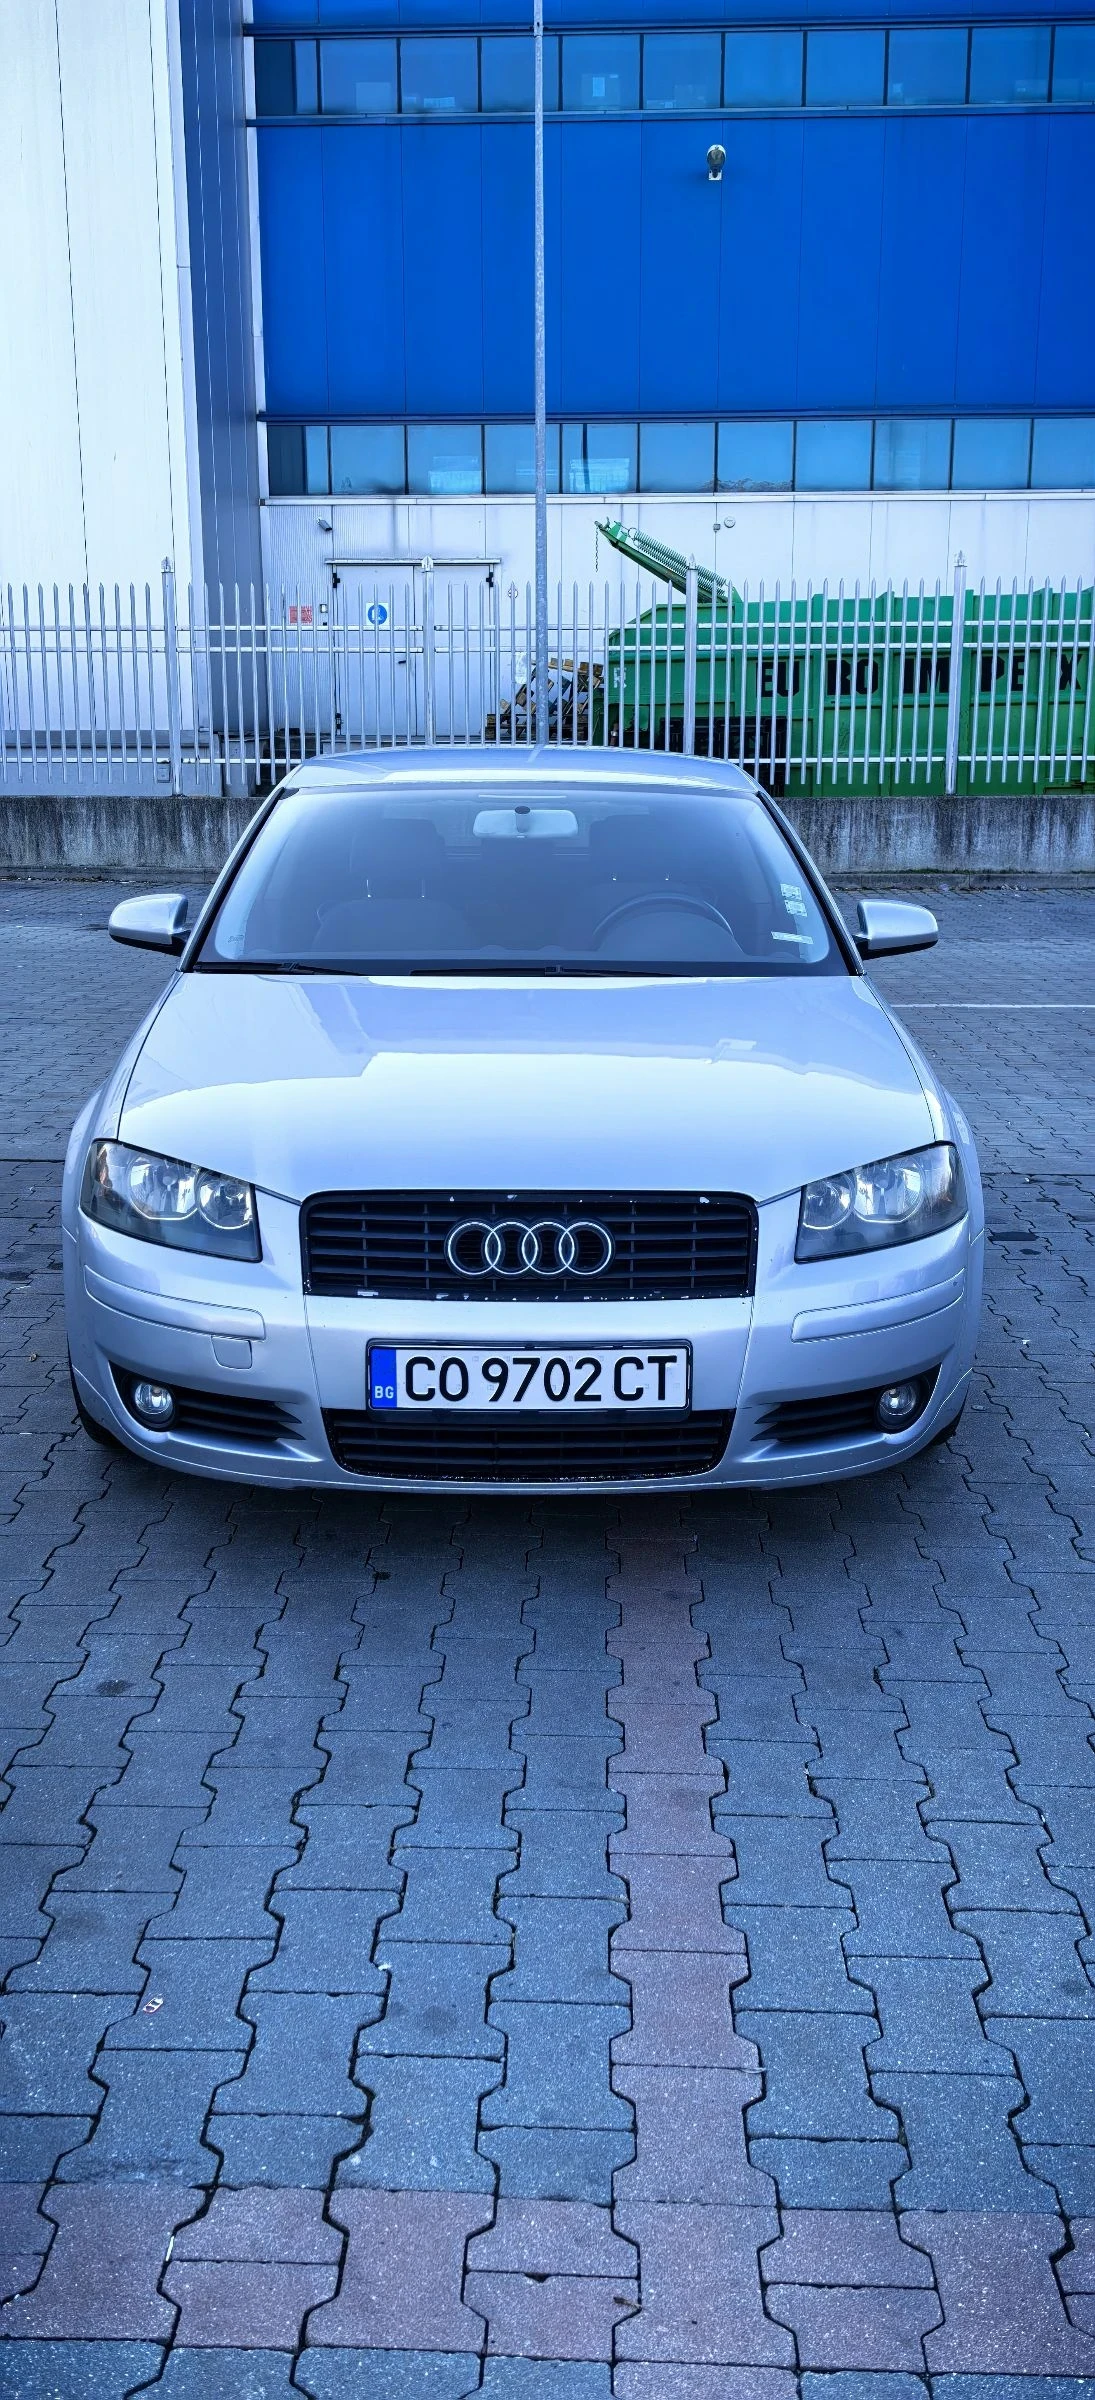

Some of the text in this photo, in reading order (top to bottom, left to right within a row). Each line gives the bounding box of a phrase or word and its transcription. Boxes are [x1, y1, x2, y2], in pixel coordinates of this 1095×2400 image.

[374, 1386, 394, 1399] BG
[405, 1355, 677, 1402] CO 9702 CT
